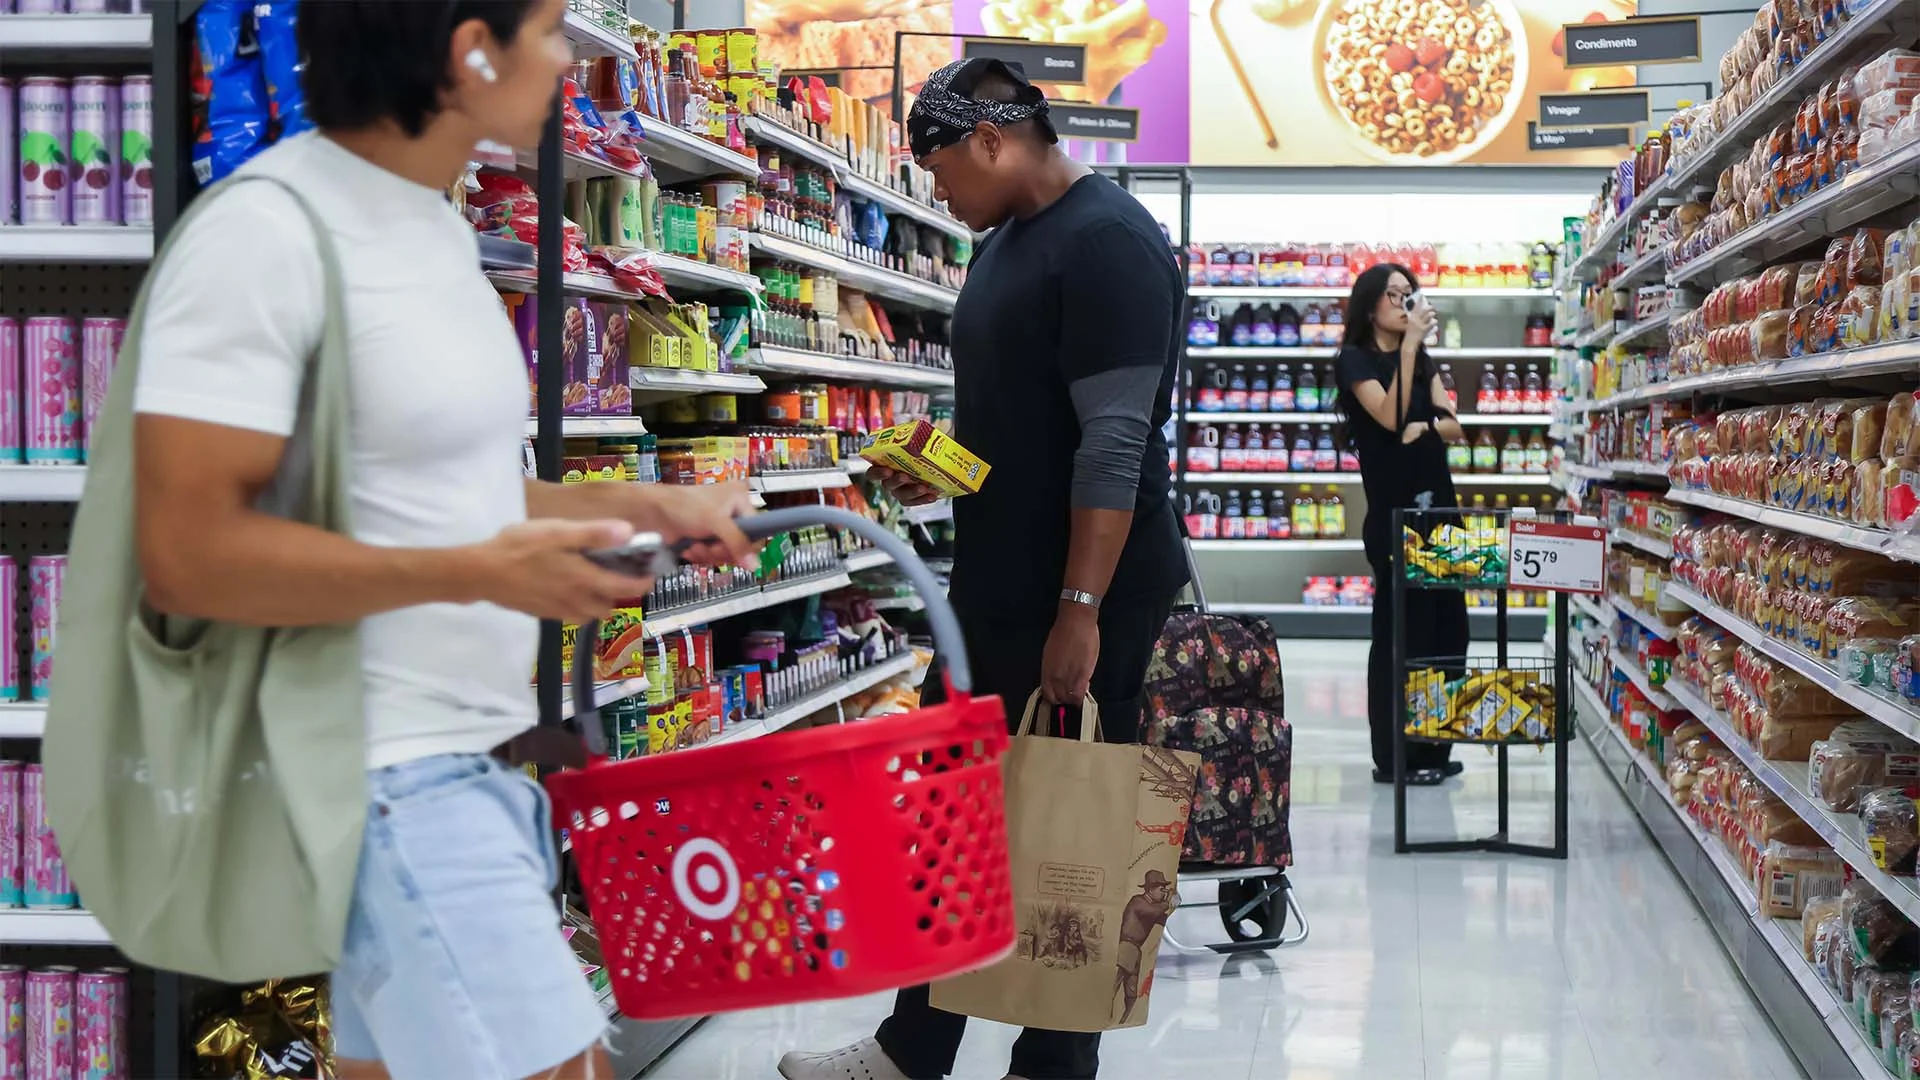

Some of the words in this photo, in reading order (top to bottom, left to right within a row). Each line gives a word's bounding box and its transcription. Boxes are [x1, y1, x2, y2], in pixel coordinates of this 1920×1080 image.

[1575, 38, 1637, 50] Condiments
[1044, 57, 1075, 68] Beans
[1547, 105, 1581, 116] Vinegar
[1535, 136, 1542, 144] &
[1543, 135, 1566, 145] Mayo
[1515, 522, 1536, 533] Sale!
